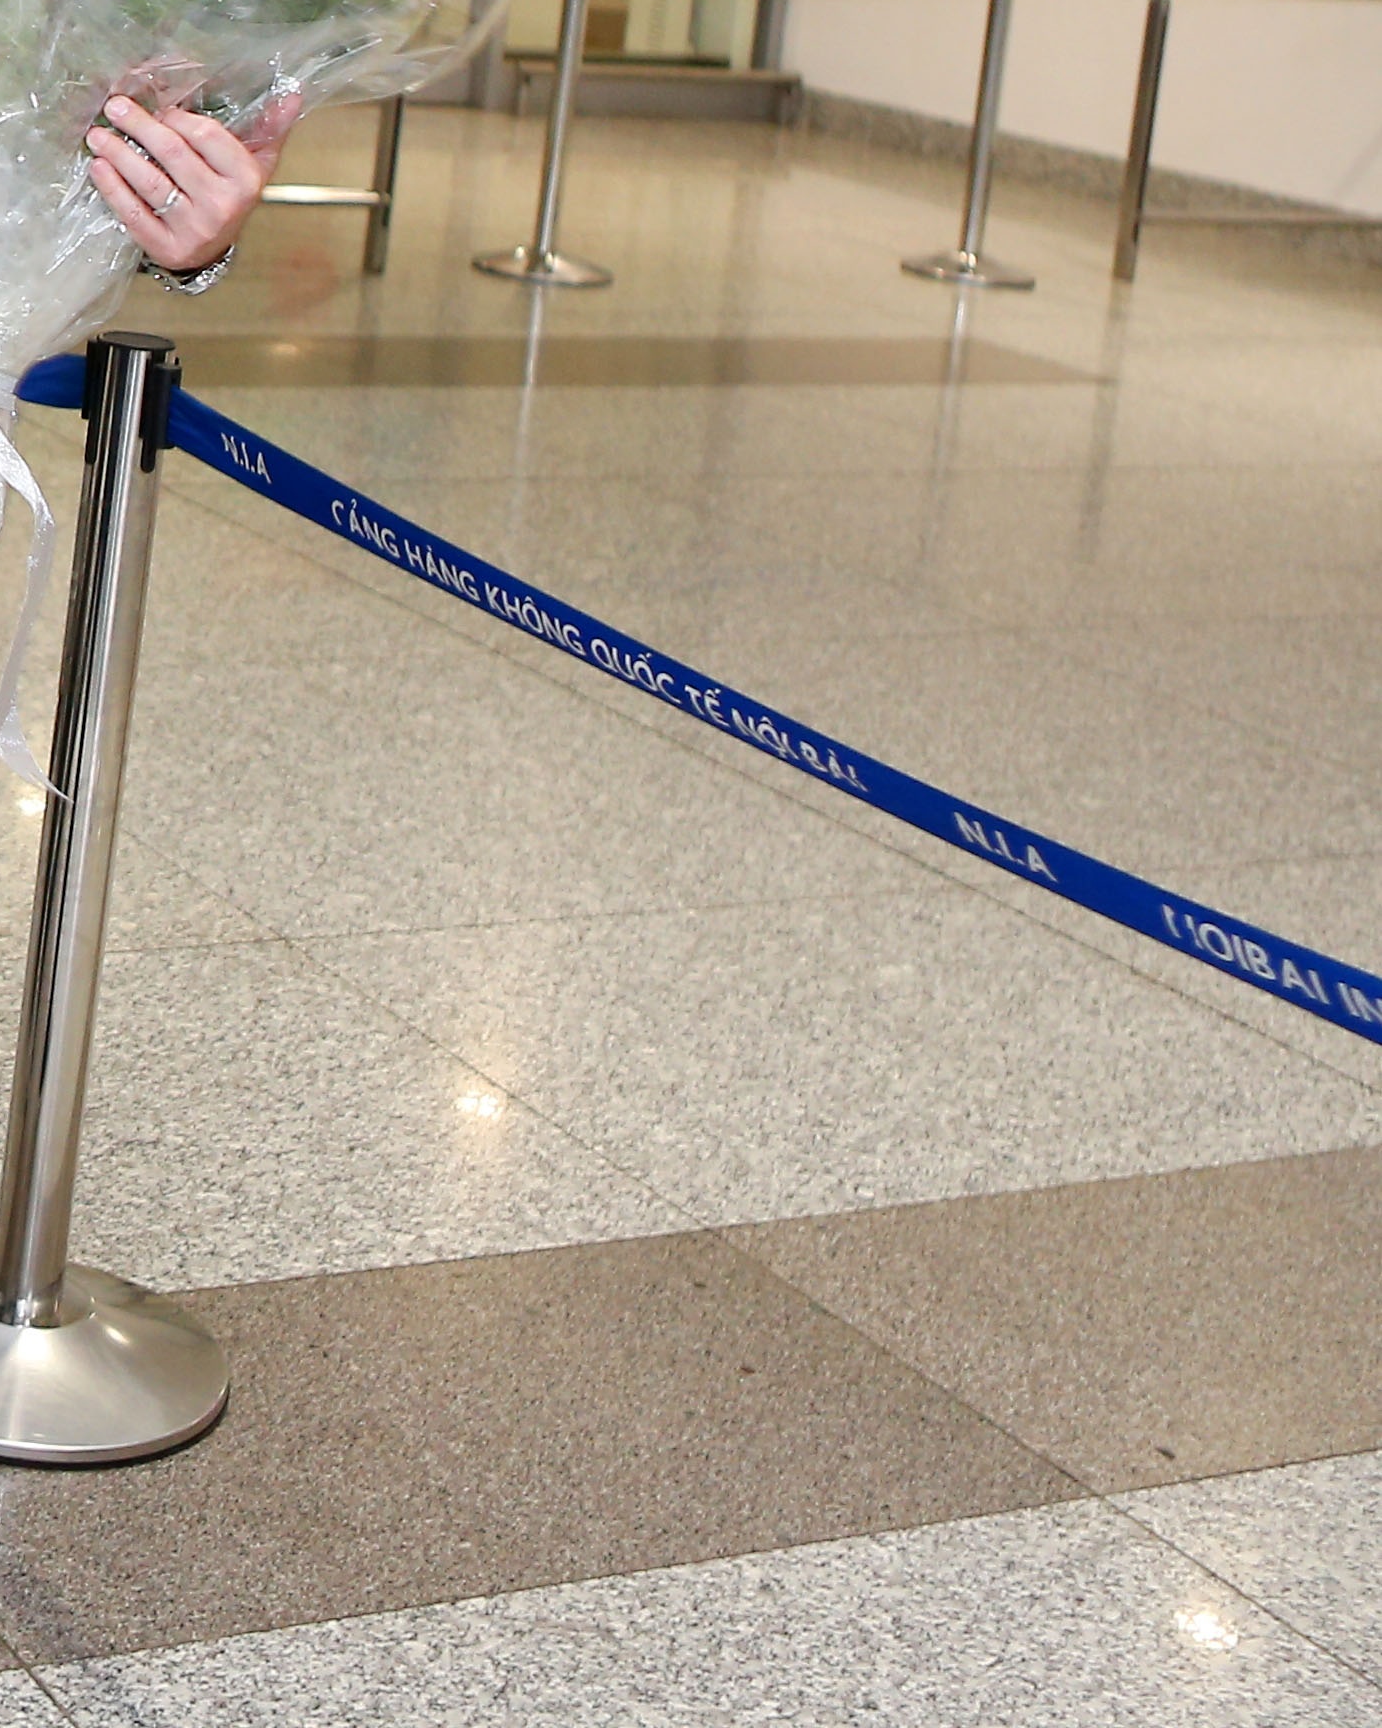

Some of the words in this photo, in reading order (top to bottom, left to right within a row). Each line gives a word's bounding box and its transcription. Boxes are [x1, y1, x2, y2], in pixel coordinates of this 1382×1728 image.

[331, 498, 400, 558] CẢNG
[484, 581, 586, 656] KHÔNG
[590, 638, 682, 704] QUỐC
[684, 685, 730, 728] TẾ
